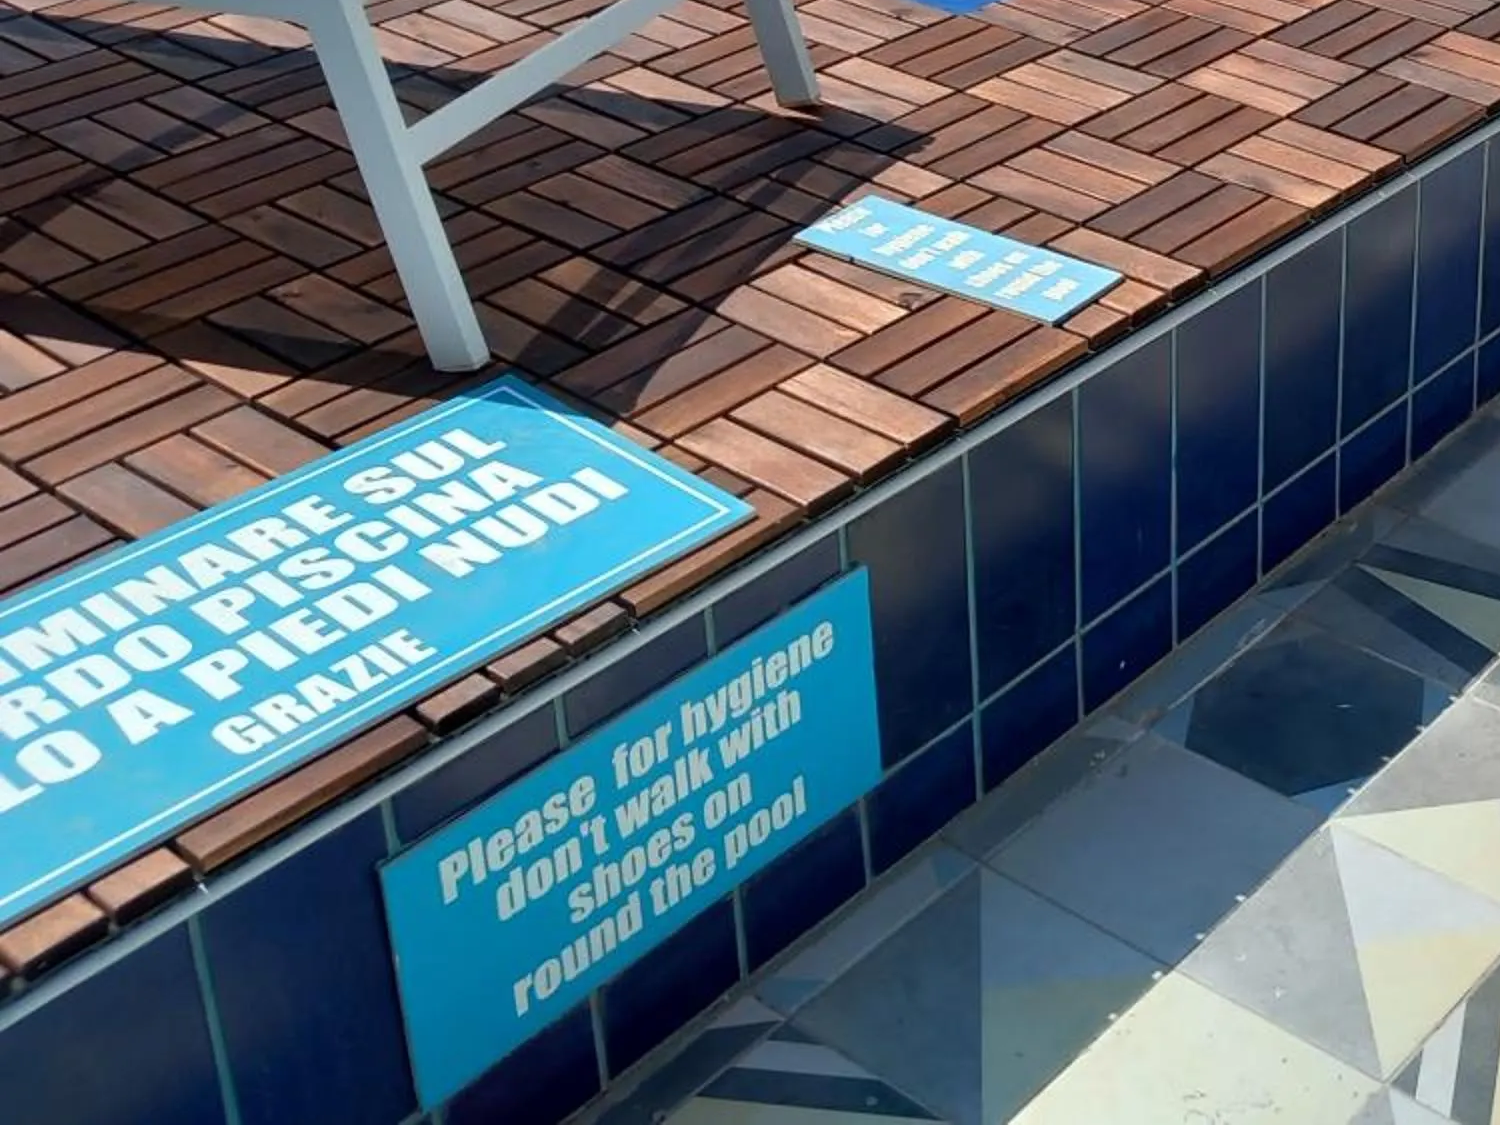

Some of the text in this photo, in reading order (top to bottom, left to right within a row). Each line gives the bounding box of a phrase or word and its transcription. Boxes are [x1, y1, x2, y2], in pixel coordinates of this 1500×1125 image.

[343, 427, 506, 505] SUL
[0, 461, 542, 741] RDO PISCINA
[106, 689, 195, 745] A
[180, 565, 432, 701] PIEDI
[420, 467, 630, 578] NUDI
[212, 630, 438, 755] GRAZIE
[438, 620, 834, 904] Please for hygiene
[497, 689, 801, 920] don't walk with
[570, 773, 751, 924] shoes on
[514, 777, 805, 1016] round the pool
